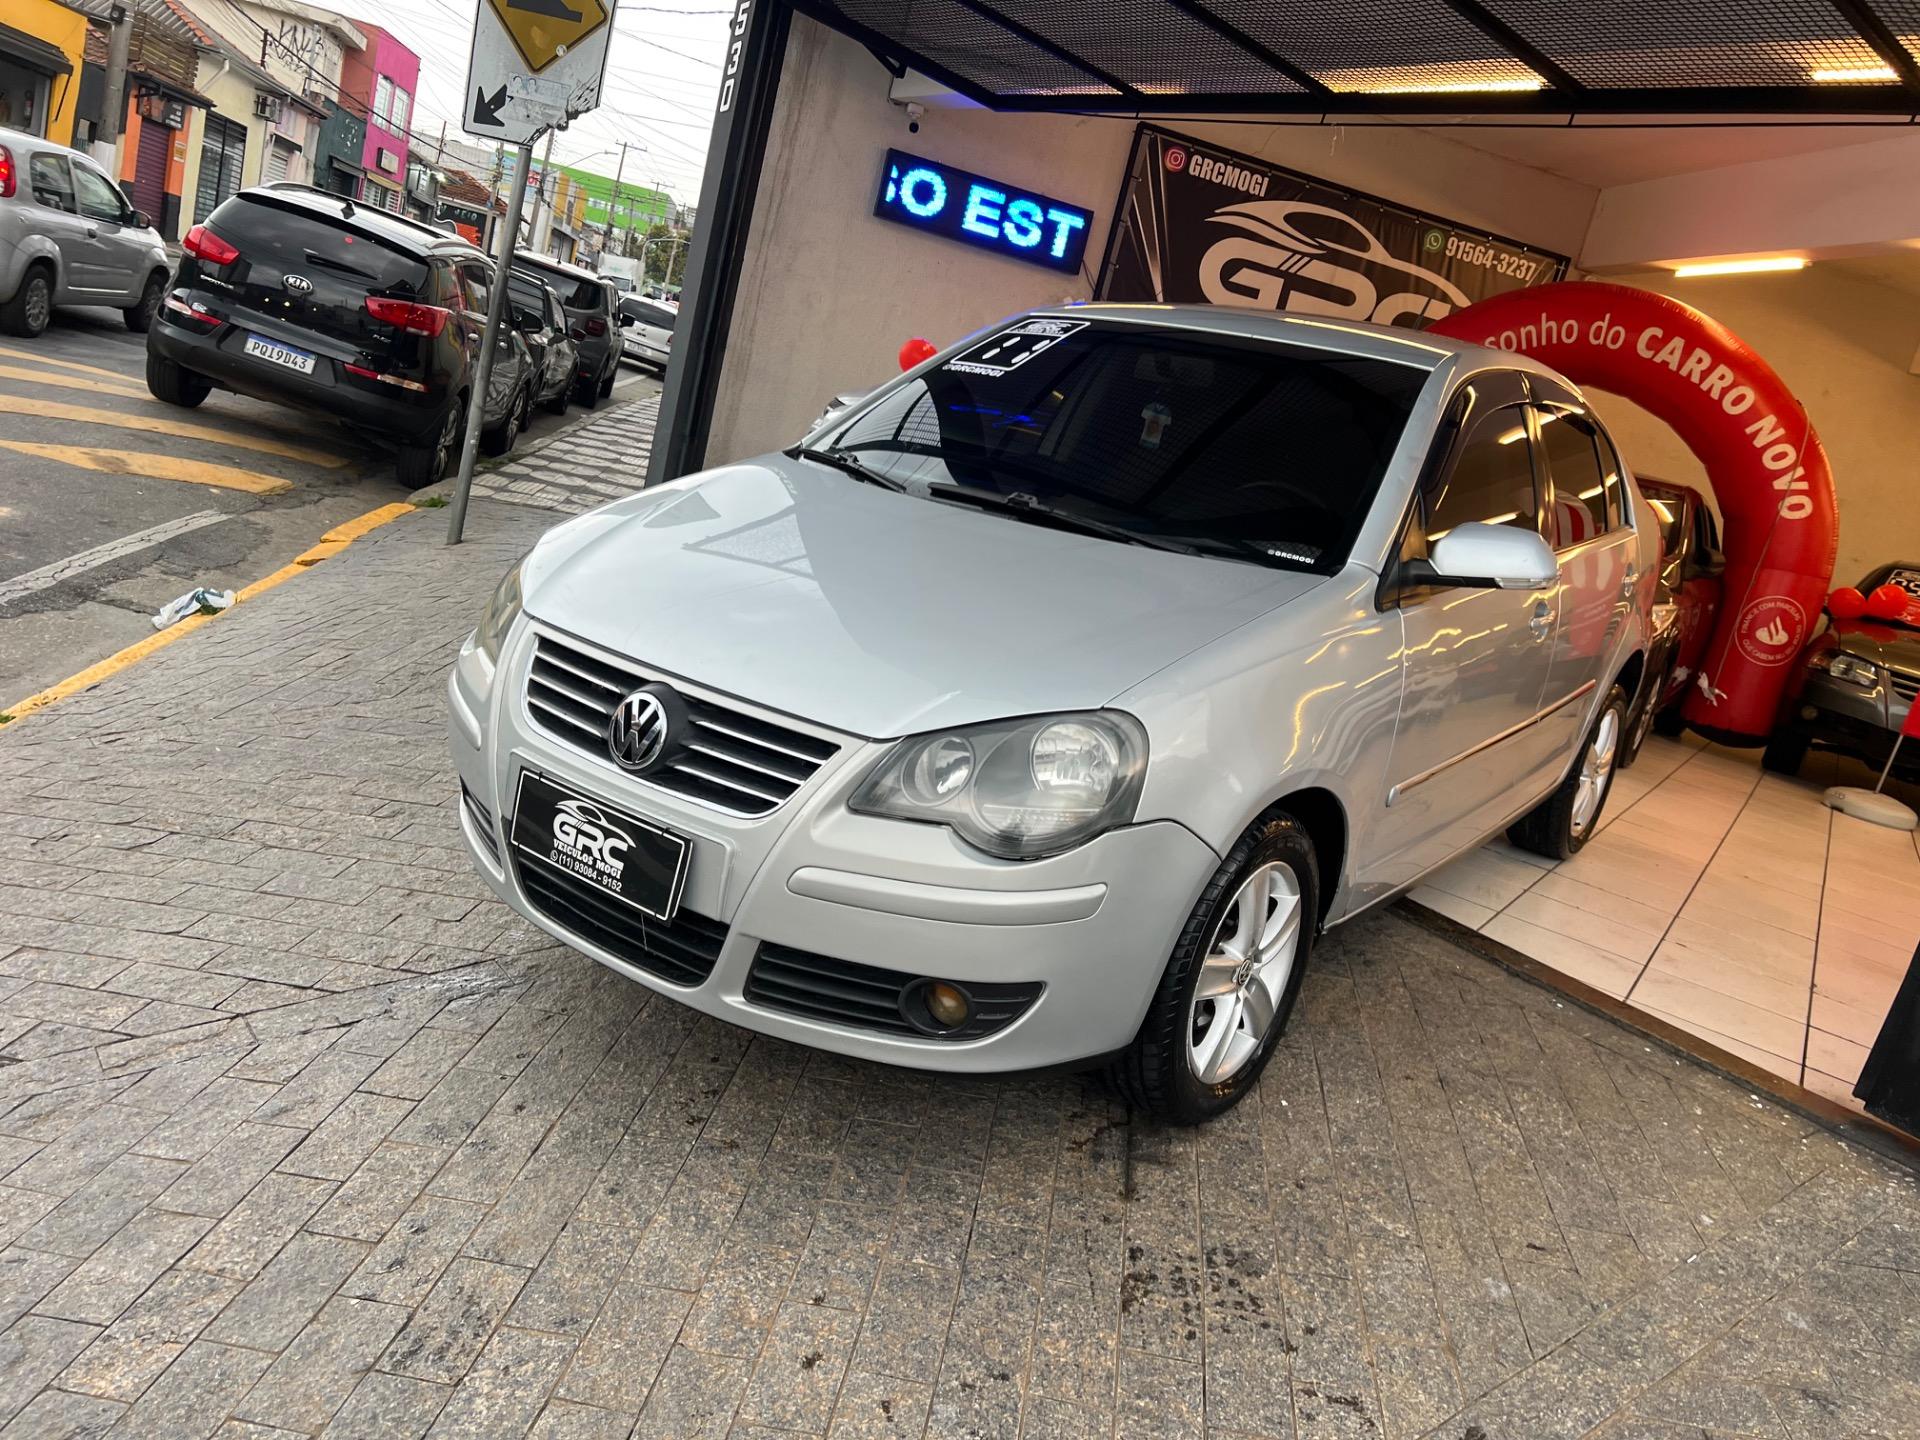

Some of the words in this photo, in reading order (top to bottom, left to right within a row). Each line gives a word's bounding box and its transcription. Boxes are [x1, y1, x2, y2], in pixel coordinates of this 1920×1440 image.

[1188, 154, 1270, 198] GRCMOGI
[961, 184, 1085, 258] EST
[1445, 236, 1537, 281] 91564-3237
[287, 275, 309, 291] KIA
[1484, 312, 1579, 352] sonho
[1588, 312, 1626, 350] do
[1636, 326, 1756, 415] CARRO
[1744, 414, 1813, 520] NOVO
[553, 812, 628, 871] GRC
[553, 838, 594, 865] VEICULOS
[596, 860, 622, 880] MOGI
[558, 853, 574, 870] (11)
[574, 861, 598, 880] 93084
[602, 875, 623, 893] 9152
